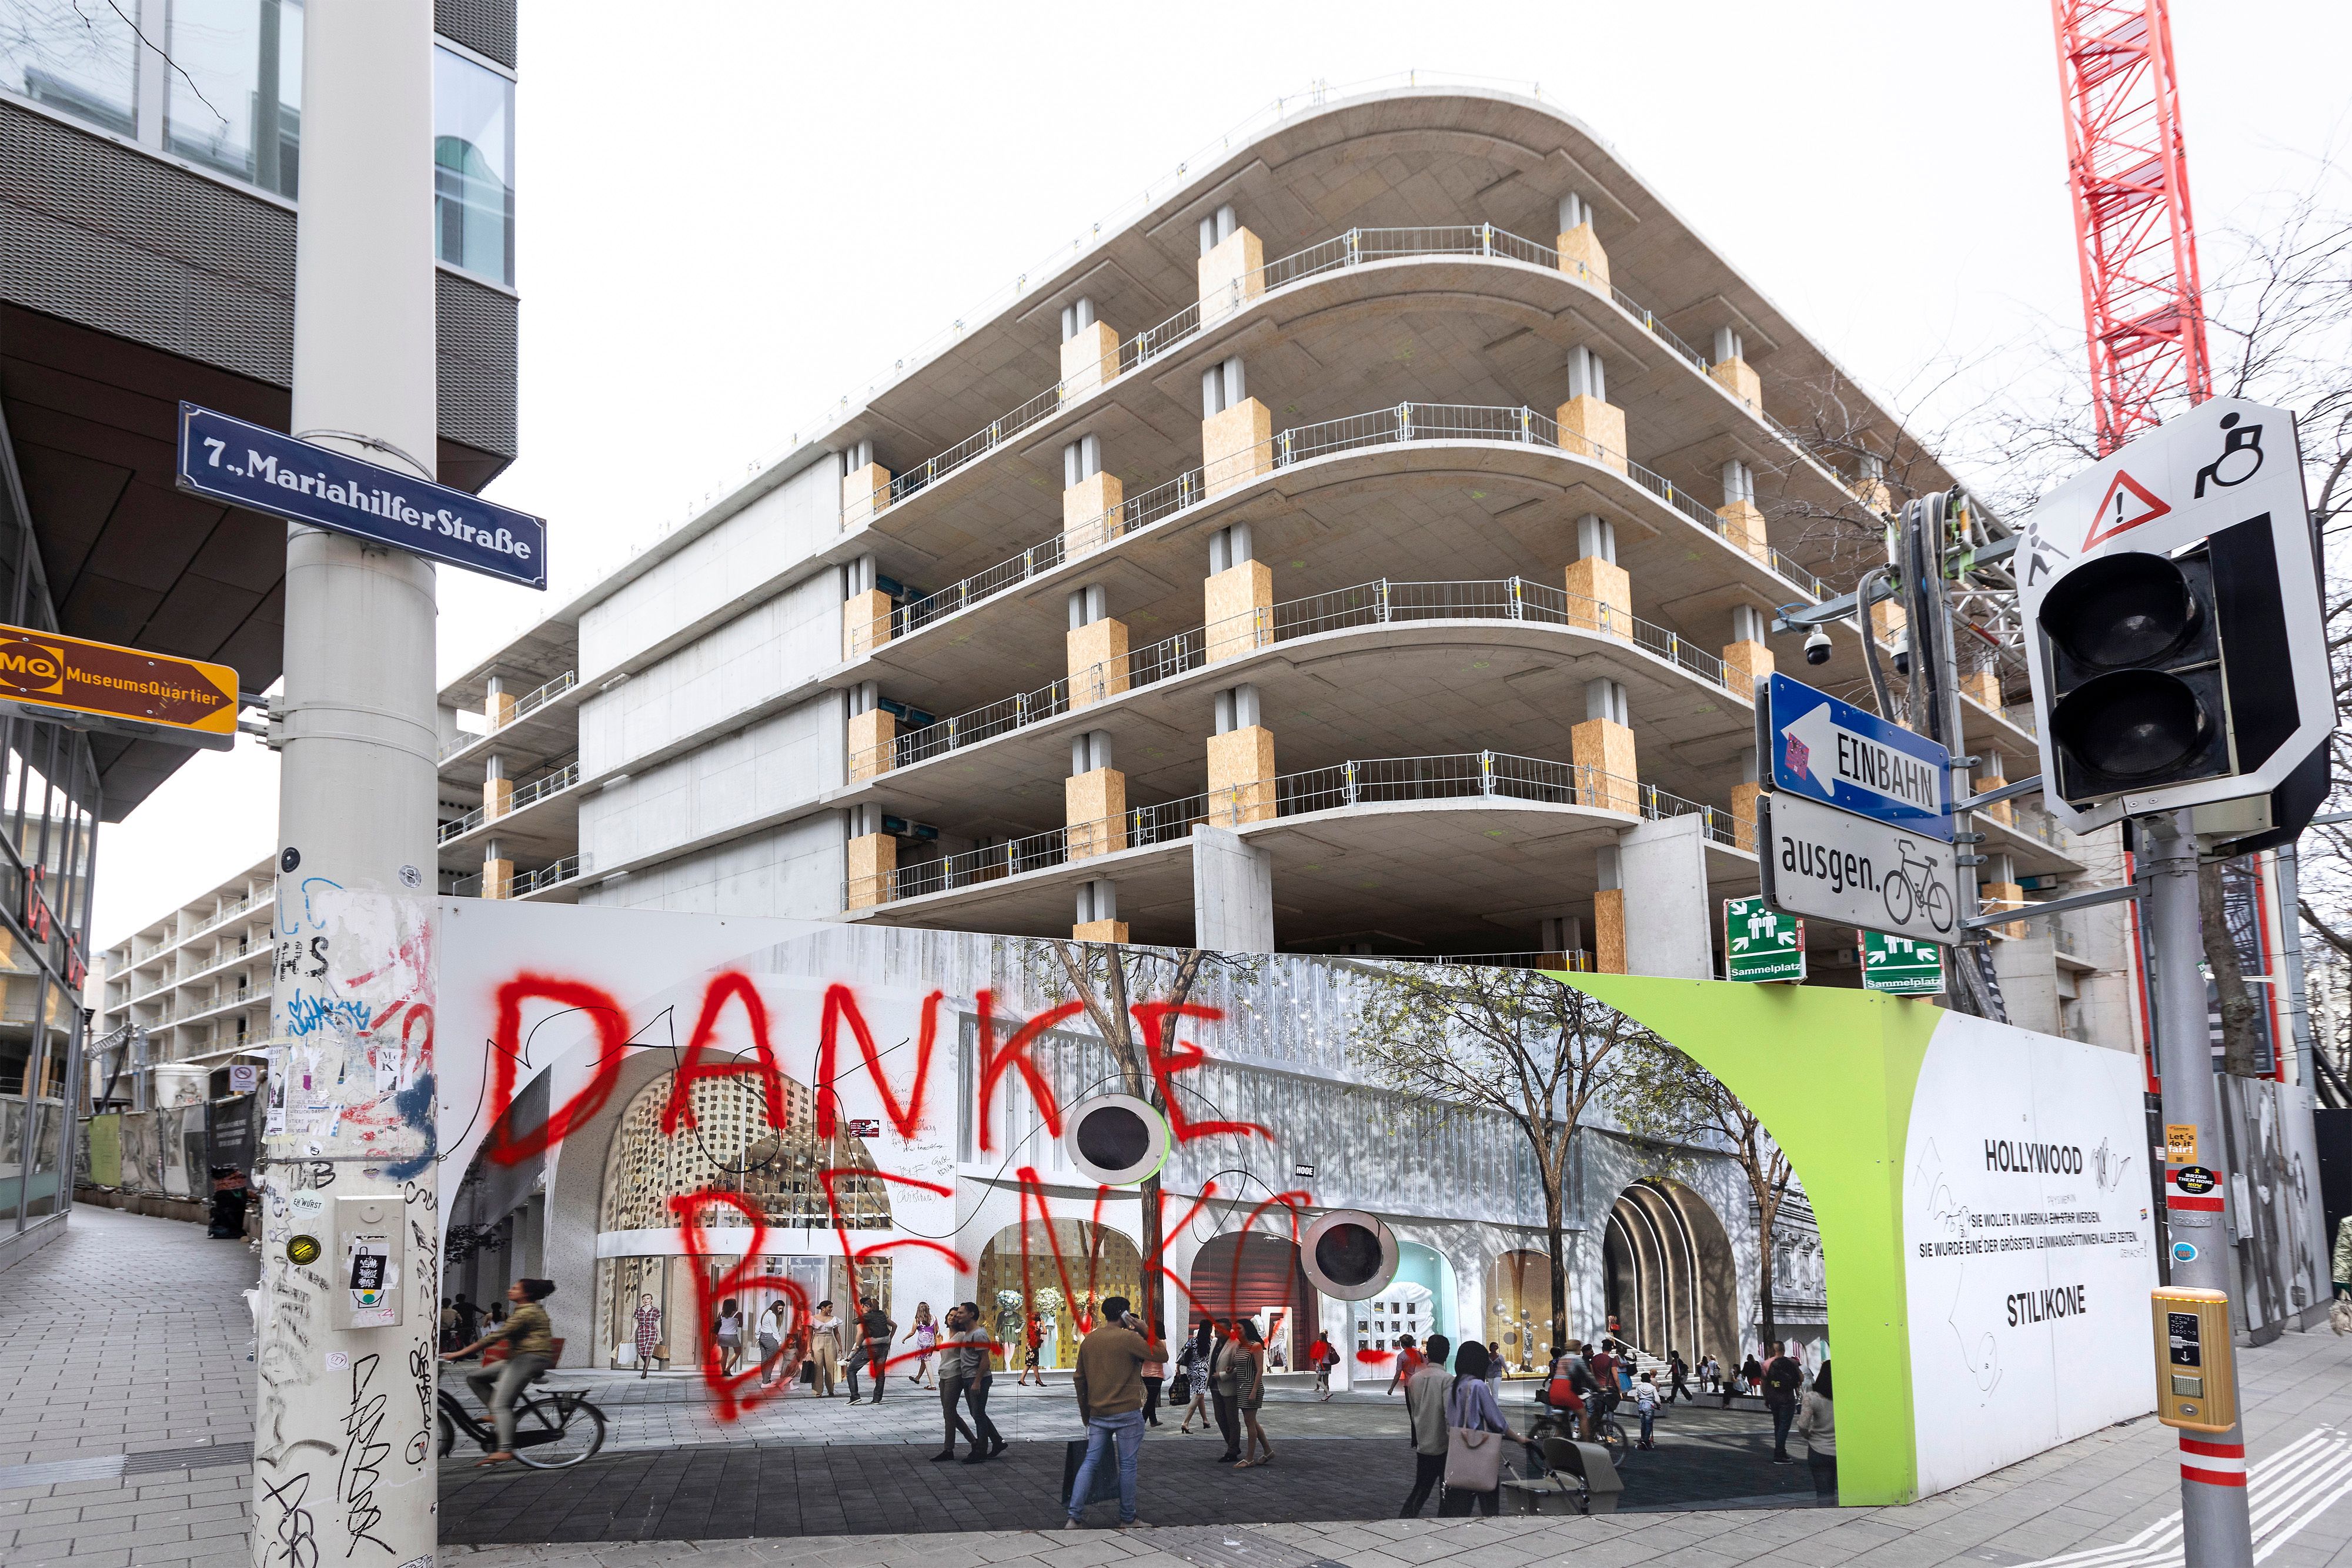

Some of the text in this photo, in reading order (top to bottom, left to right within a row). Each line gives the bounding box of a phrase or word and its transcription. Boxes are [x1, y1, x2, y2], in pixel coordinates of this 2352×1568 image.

[246, 449, 436, 531] Mariahilfer
[437, 509, 532, 560] Straße
[0, 651, 219, 706] MQ MuseumsQuartier
[1838, 732, 1933, 808] EINBAHN
[1782, 836, 1880, 894] ausgen.
[1732, 962, 1801, 977] Sammelplatz
[1867, 977, 1941, 989] Sammelplatz
[489, 971, 1274, 1165] DANKE
[1984, 1139, 2083, 1175] HOLLYWOOD
[2168, 1145, 2193, 1154] fair!
[301, 1198, 322, 1209] WURST
[1972, 1211, 2102, 1228] SIE WOLLTE IN AMERIKA EIN STAR WERDEN.
[1919, 1231, 2139, 1258] SIE WURDE EINE DER GRÖSSTEN LEINWANDGÖTTINNEN ALLER ZEITEN.
[670, 1166, 1311, 1423] BENKO
[2007, 1284, 2086, 1328] STILIKONE
